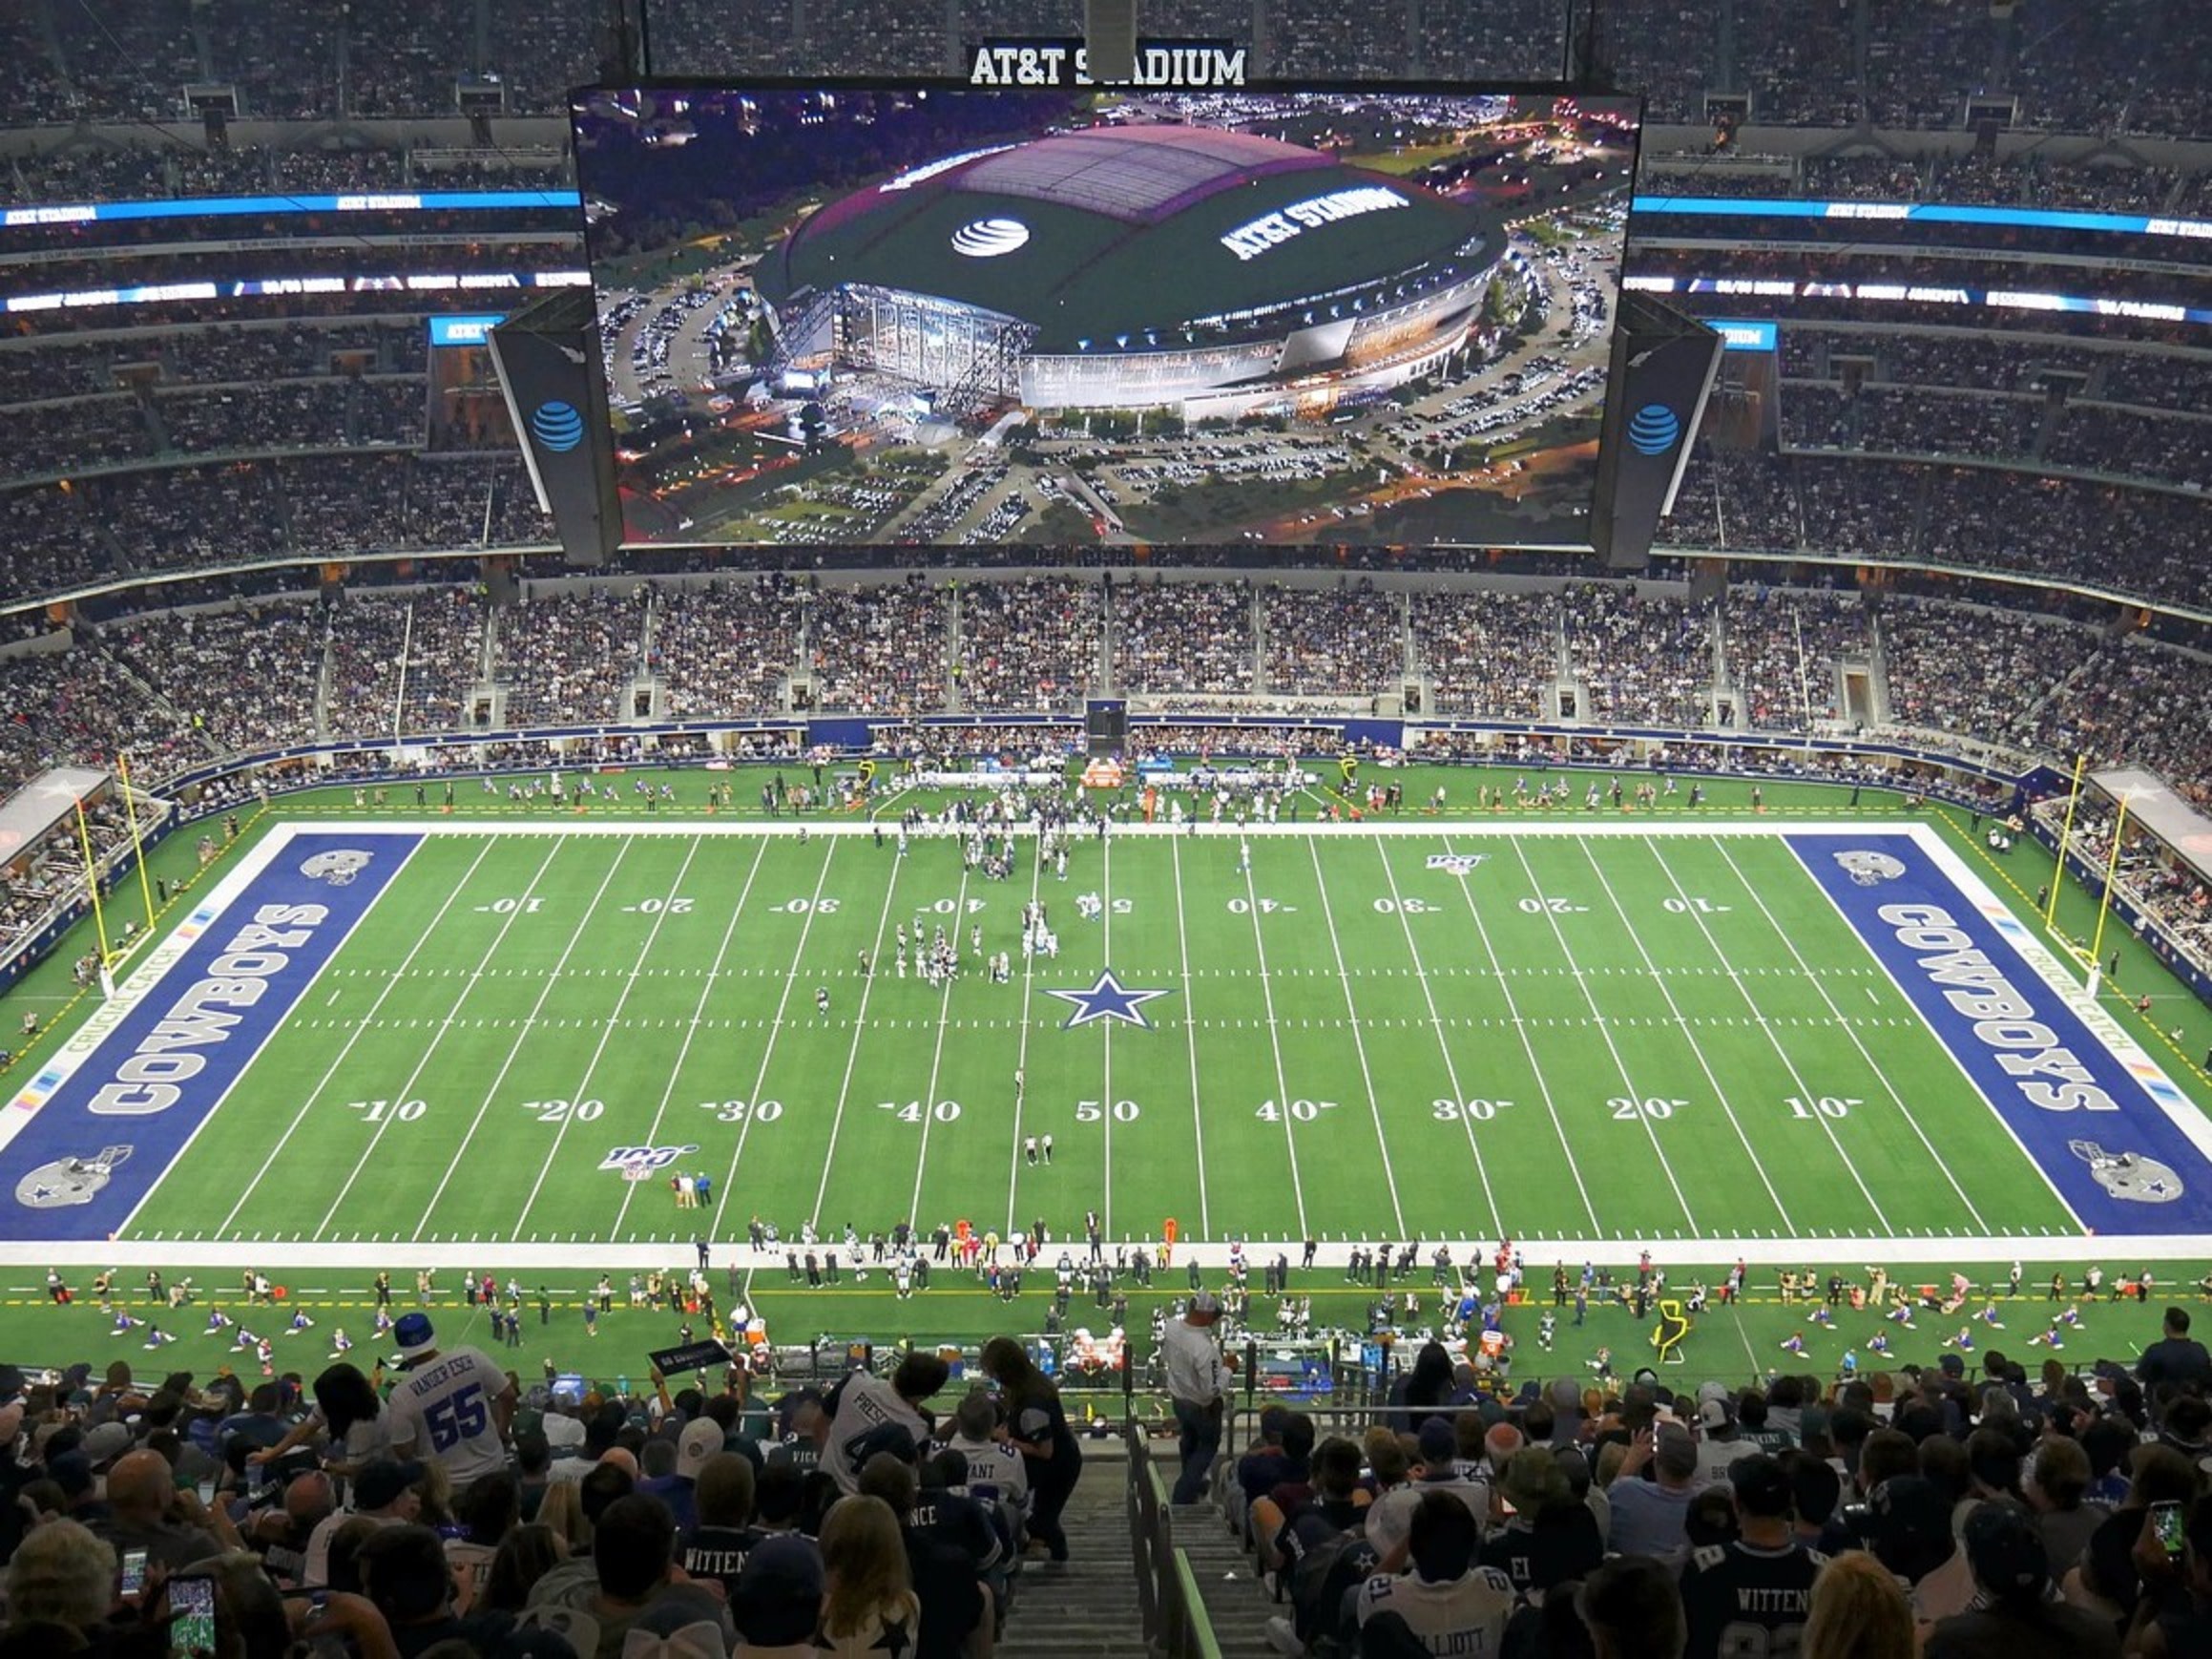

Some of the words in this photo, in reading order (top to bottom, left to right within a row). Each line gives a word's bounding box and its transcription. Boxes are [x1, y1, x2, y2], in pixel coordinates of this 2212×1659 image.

[970, 48, 1065, 84] AT&T
[1221, 212, 1301, 261] AT&T
[492, 898, 545, 914] 10
[640, 898, 695, 914] 20
[787, 898, 840, 914] 30
[934, 899, 987, 914] 40
[1227, 899, 1279, 914] 40
[1373, 898, 1428, 914] 30
[1518, 898, 1576, 914] 20
[1663, 898, 1715, 914] 10
[125, 948, 181, 991] CATCH
[88, 904, 329, 1115] COWBOYS
[1877, 904, 2119, 1111] COWBOYS
[2075, 1003, 2136, 1049] CATCH
[360, 1101, 427, 1122] 10
[537, 1101, 604, 1122] 20
[717, 1101, 783, 1122] 30
[896, 1101, 962, 1122] 40
[1075, 1101, 1139, 1122] 50
[1255, 1101, 1318, 1122] 40
[1432, 1099, 1495, 1120] 30
[1606, 1098, 1673, 1120] 20
[1784, 1097, 1848, 1119] 10
[409, 1365, 449, 1397] VANDER
[449, 1354, 475, 1377] ESCH
[424, 1382, 488, 1454] 55
[685, 1547, 749, 1574] WITTEN
[1737, 1587, 1812, 1612] WITTEN
